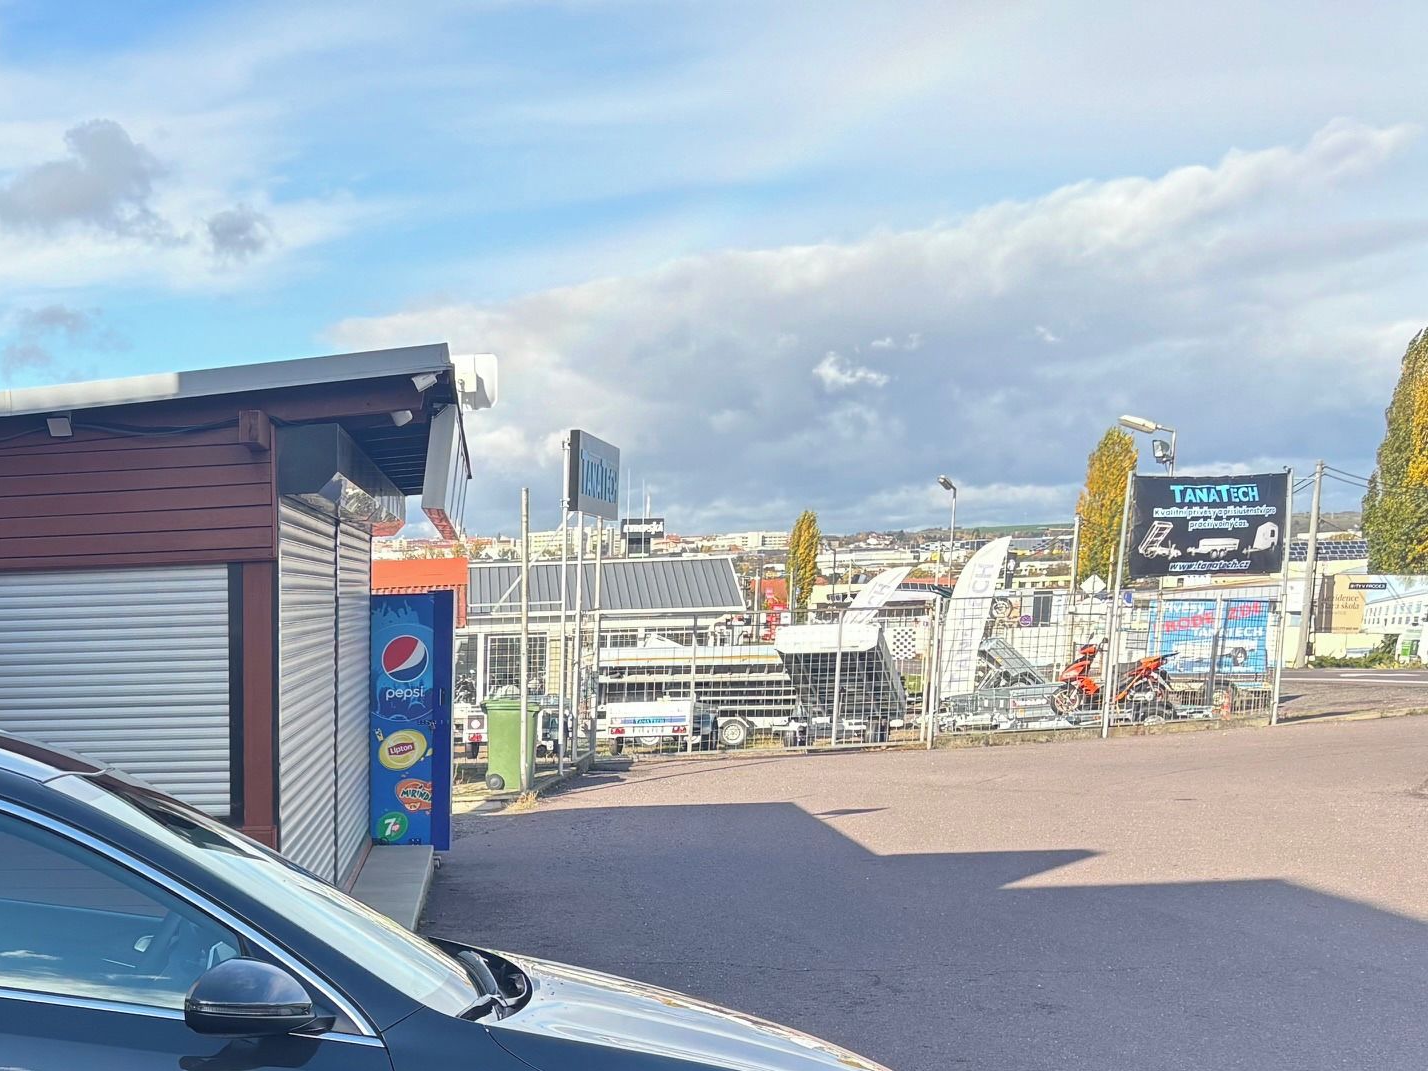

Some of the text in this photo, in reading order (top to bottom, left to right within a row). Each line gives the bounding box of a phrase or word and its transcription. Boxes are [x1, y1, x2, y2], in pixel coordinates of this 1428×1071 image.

[1170, 484, 1260, 503] TANATECH
[1169, 559, 1251, 572] www.tanatech.cz
[385, 685, 425, 701] pepsi
[389, 743, 413, 755] Lipton
[400, 787, 431, 801] MIRIND
